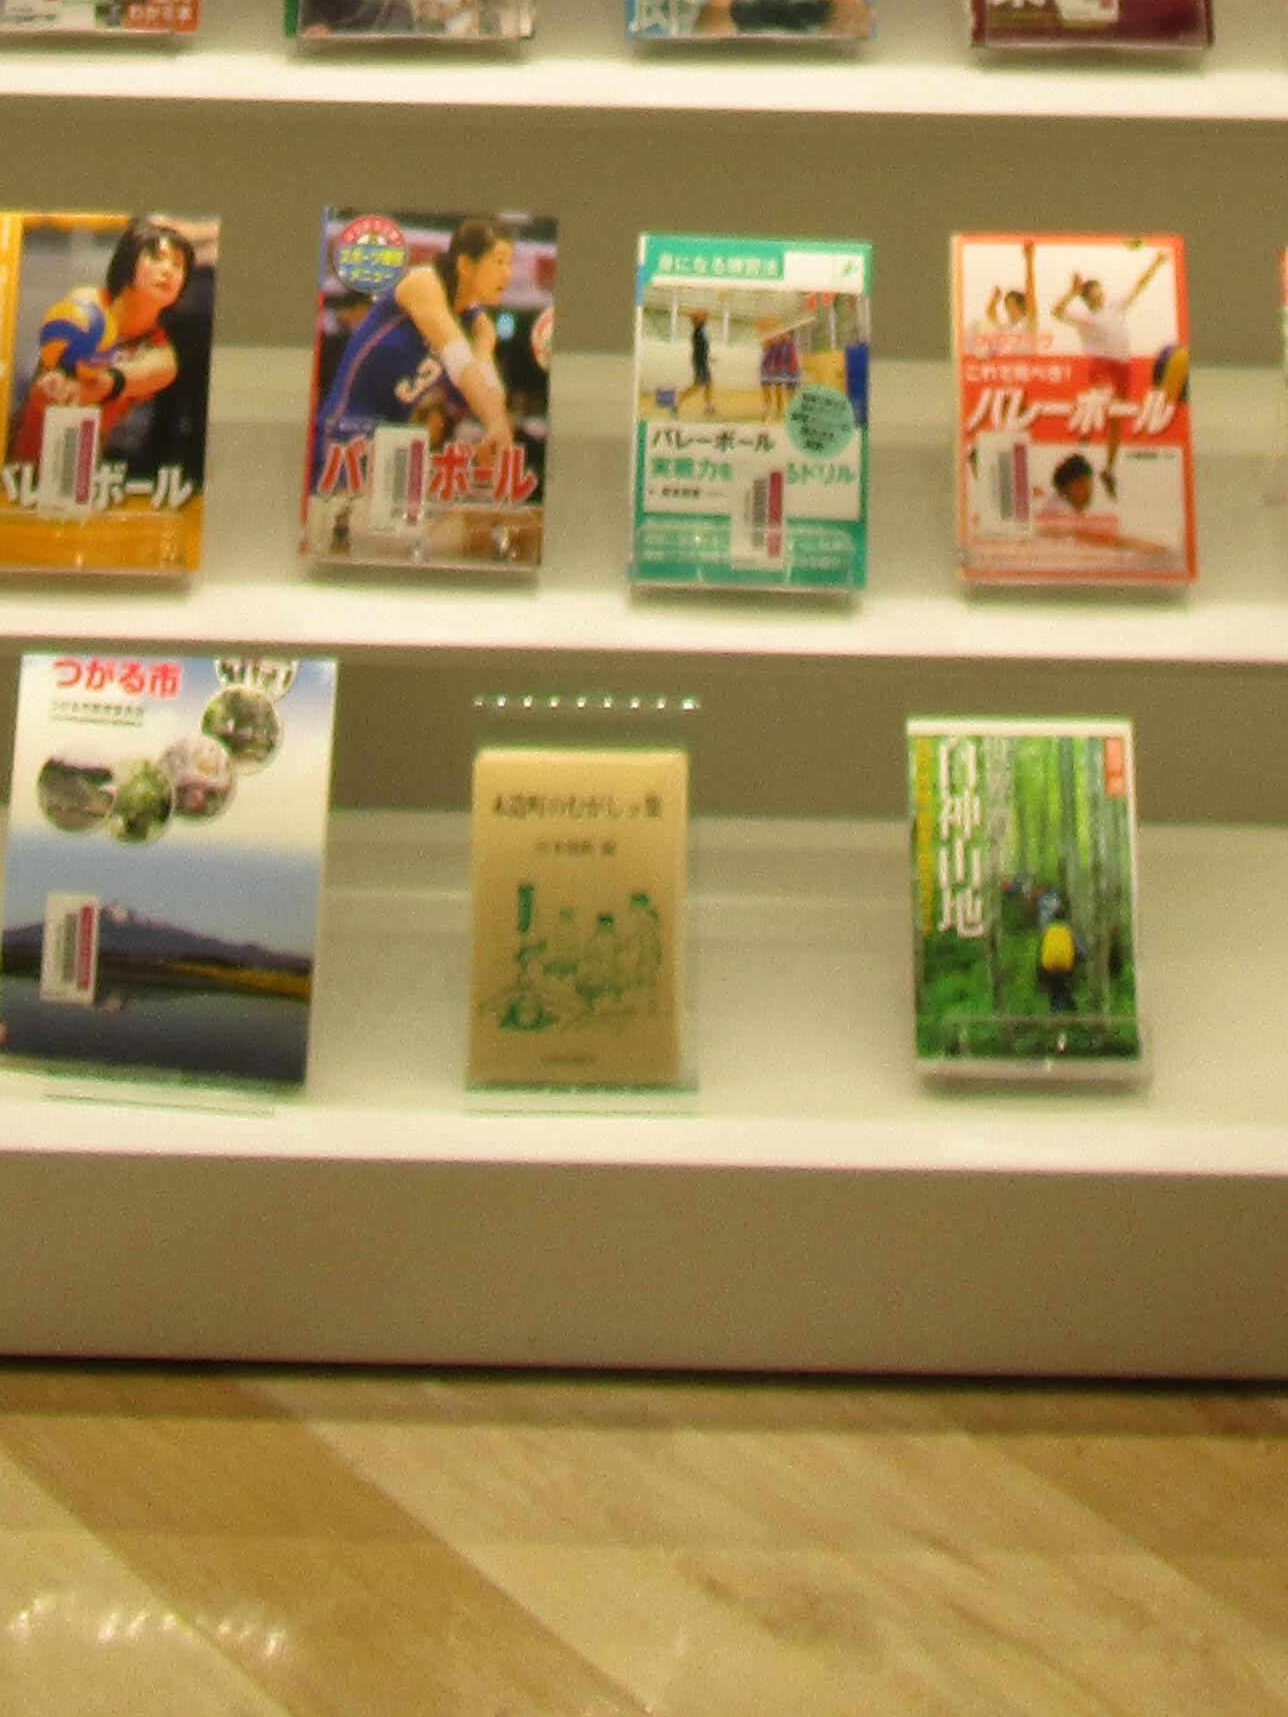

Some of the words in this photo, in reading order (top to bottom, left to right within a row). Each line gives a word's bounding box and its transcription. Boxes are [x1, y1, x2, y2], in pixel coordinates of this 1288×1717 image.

[965, 386, 1176, 437] バレーボール
[651, 427, 776, 455] バレーボール
[51, 655, 182, 699] つがる市
